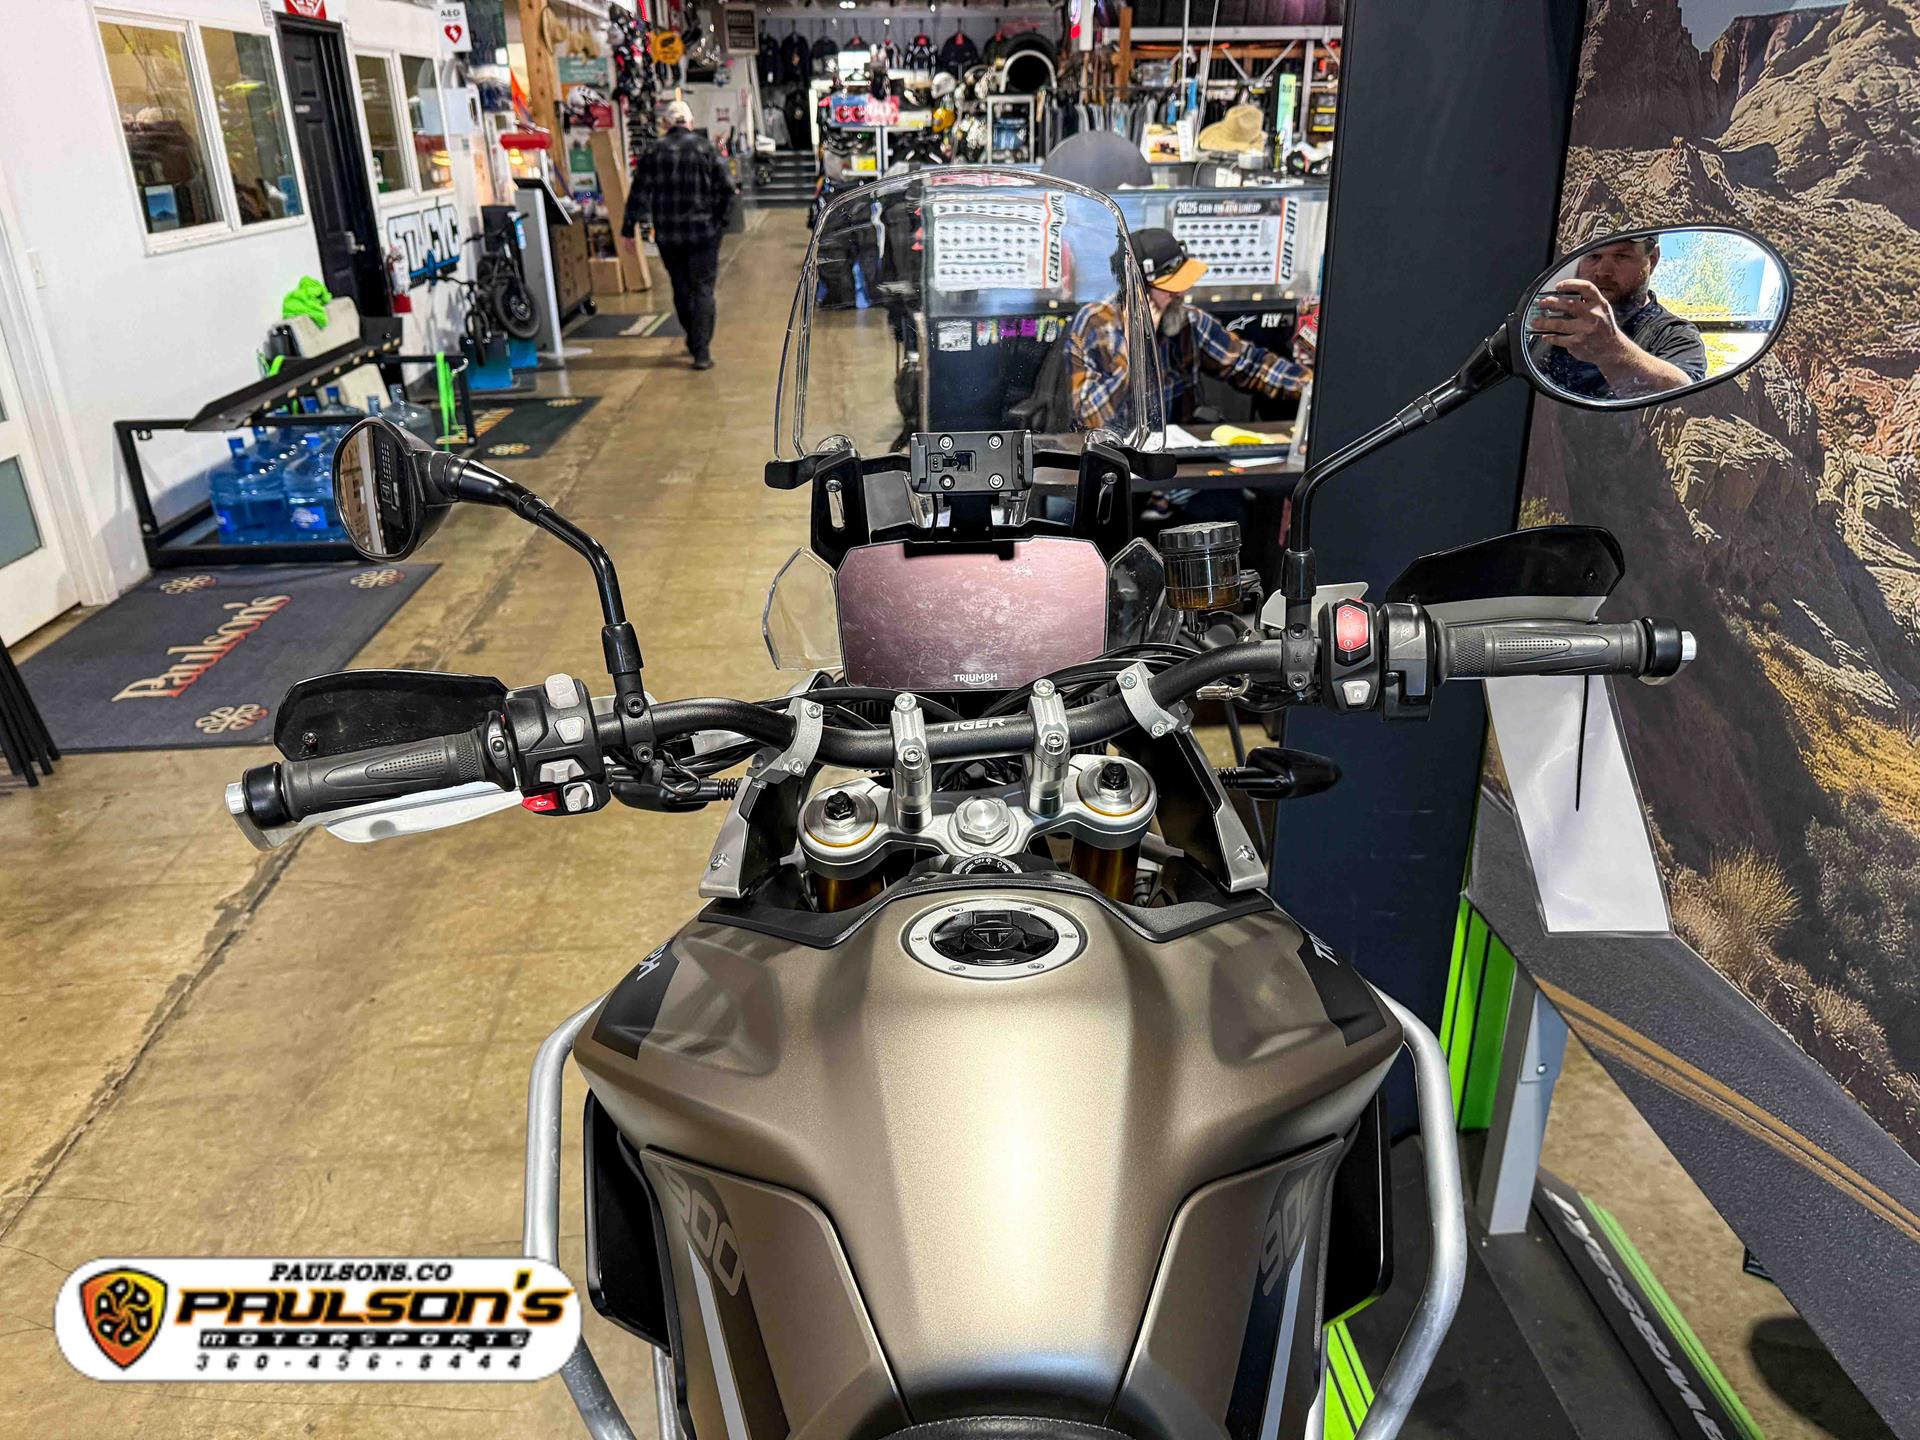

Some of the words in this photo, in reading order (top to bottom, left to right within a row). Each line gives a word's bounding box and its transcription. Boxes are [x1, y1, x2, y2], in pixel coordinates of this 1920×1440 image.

[1177, 201, 1198, 214] 2025
[1261, 313, 1281, 328] FLY
[112, 595, 290, 702] Paulson's
[953, 673, 998, 685] TRIUMPH
[939, 718, 1006, 733] TIGER
